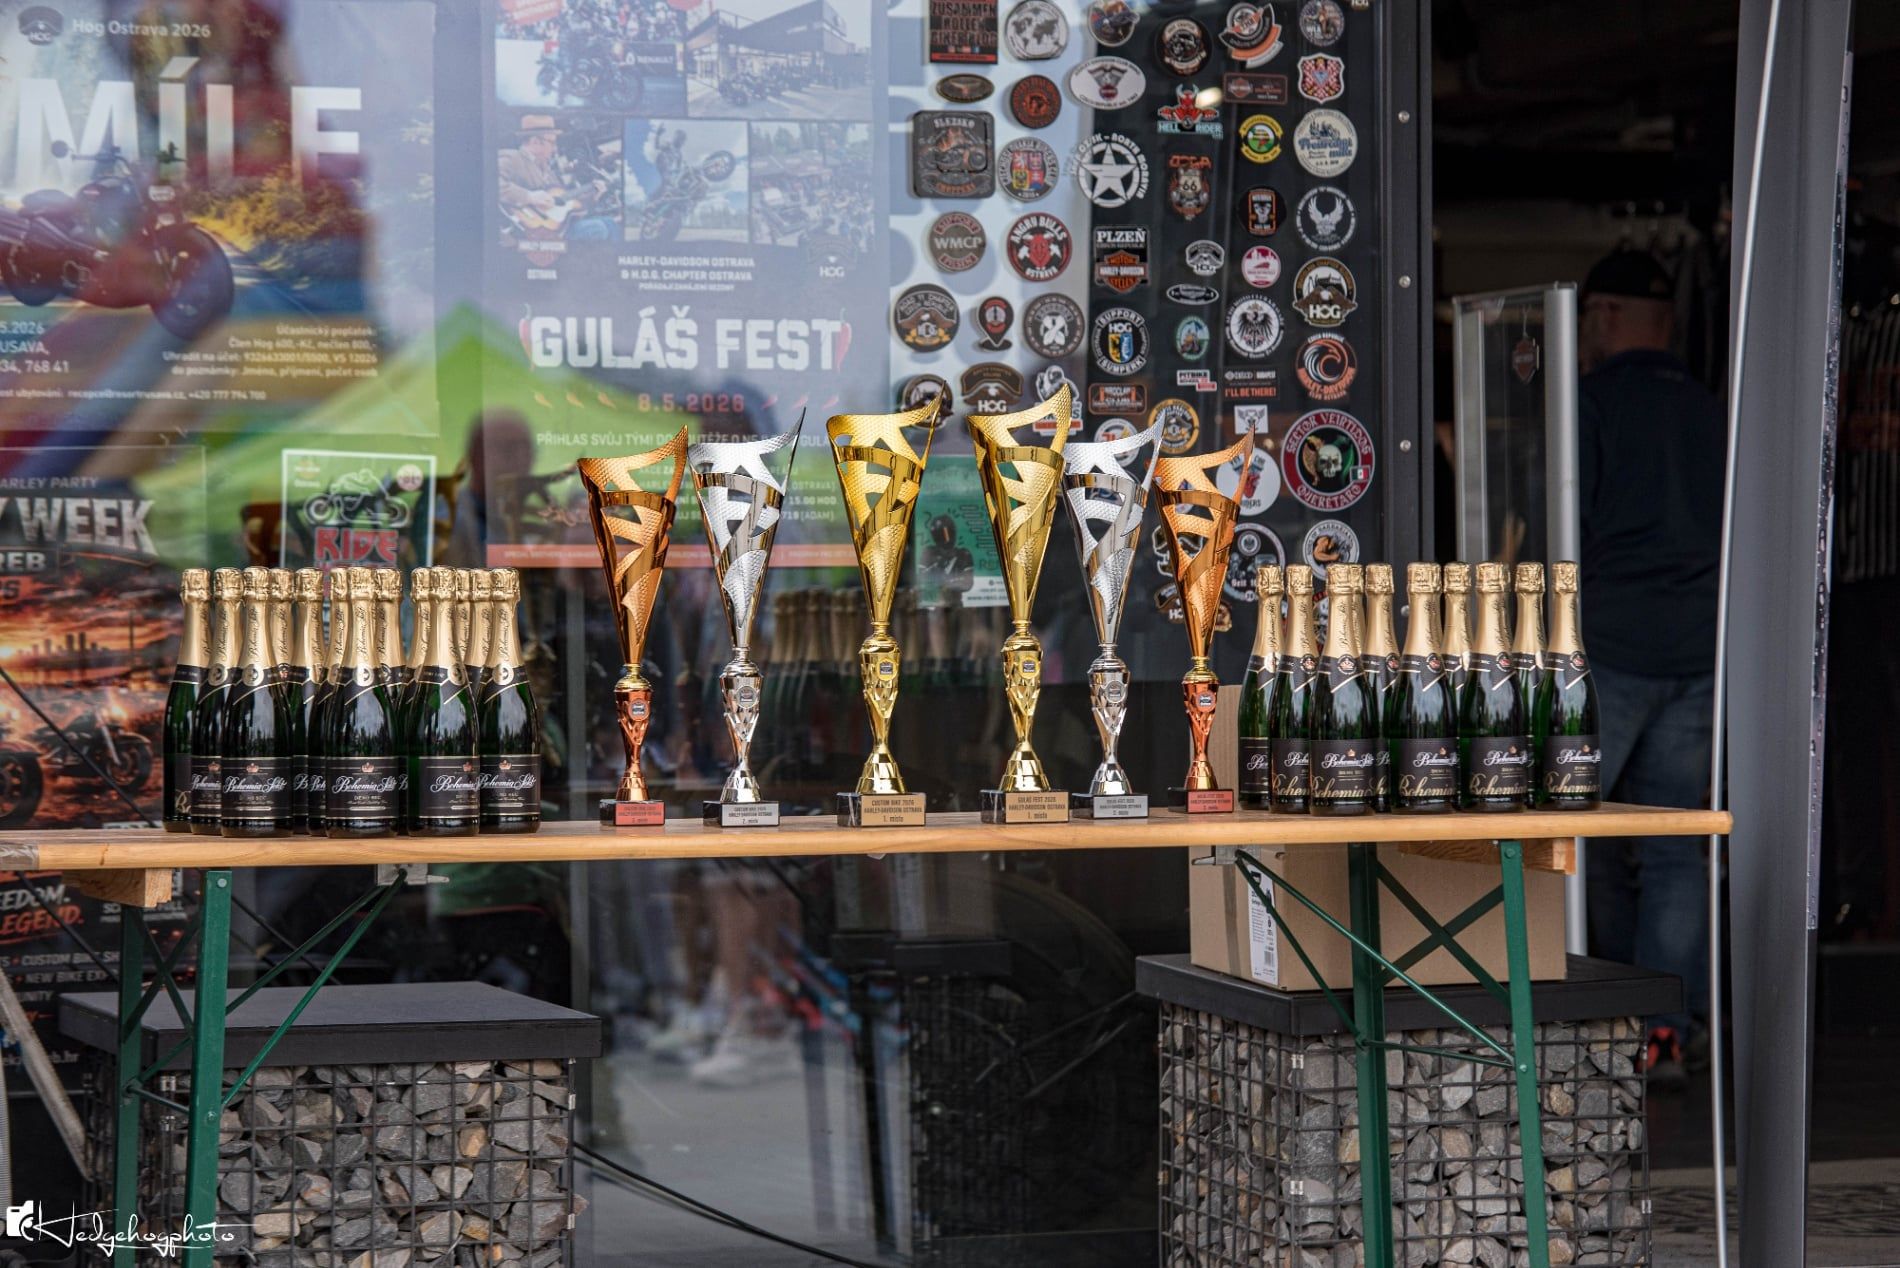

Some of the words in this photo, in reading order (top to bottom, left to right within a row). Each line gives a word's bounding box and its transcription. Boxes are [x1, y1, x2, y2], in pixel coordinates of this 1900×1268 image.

[72, 20, 104, 38] Hog
[108, 20, 168, 36] Ostrava
[172, 24, 211, 38] 2026
[1182, 181, 1198, 191] 66
[1010, 216, 1039, 244] ANGRY
[1039, 215, 1067, 241] BULLS
[1096, 227, 1147, 243] PLZEŇ
[934, 236, 982, 249] WMCP
[618, 255, 709, 267] HARLEY-DAVIDSON
[711, 257, 755, 268] OSTRAVA
[662, 270, 707, 281] CHAPTER
[709, 271, 752, 281] OSTRAVA
[1098, 308, 1142, 328] SUPPORT
[1309, 304, 1342, 319] HOG
[1108, 323, 1133, 333] HOG
[530, 305, 699, 369] GULÁŠ
[716, 317, 841, 371] FEST
[25, 360, 51, 373] 768
[53, 360, 69, 373] 41
[637, 393, 744, 413] 8.5.2026
[977, 400, 1008, 412] HOG
[536, 431, 588, 446] PŘIHLAS
[591, 432, 622, 446] SVŮJ
[50, 476, 98, 488] PARTY
[15, 497, 159, 558] WEEK
[315, 526, 399, 562] RIDE
[0, 552, 46, 572] EB
[1321, 752, 1361, 768] Bohemia
[223, 775, 264, 794] Bohemia
[331, 775, 379, 795] Bohemia
